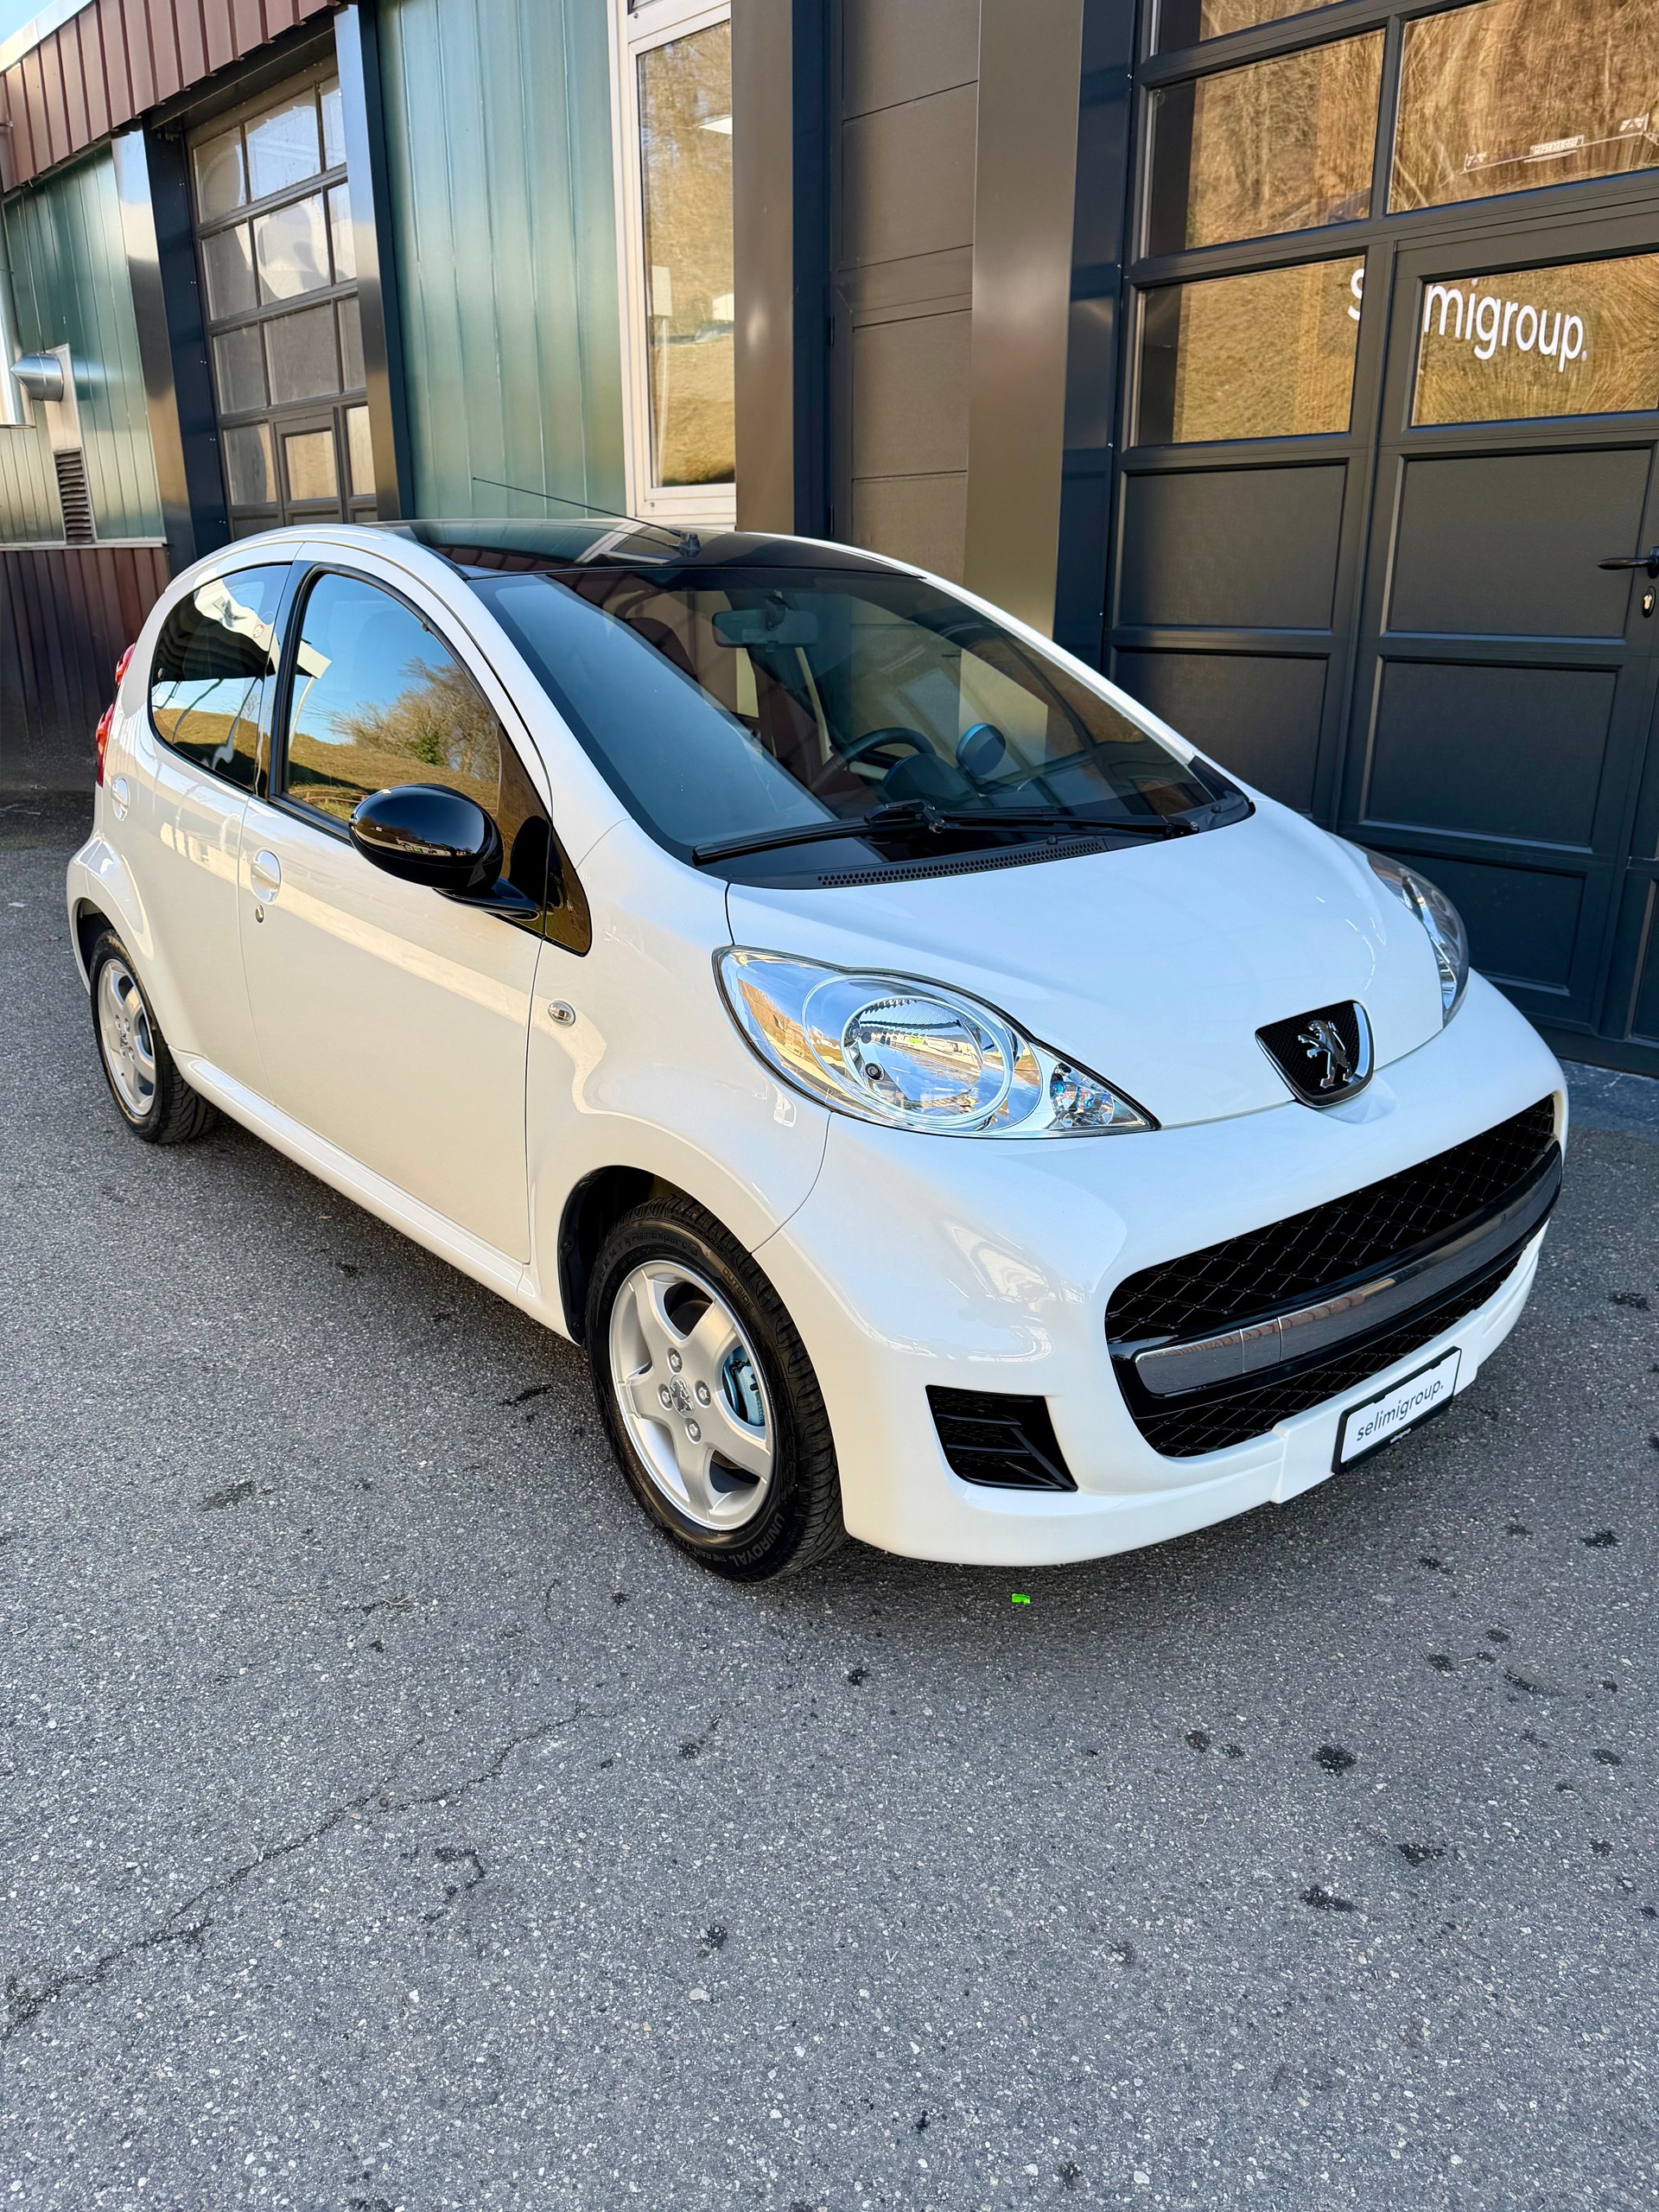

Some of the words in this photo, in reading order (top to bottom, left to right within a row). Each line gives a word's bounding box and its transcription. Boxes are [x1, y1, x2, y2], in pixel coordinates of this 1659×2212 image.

[722, 1267, 754, 1309] OUTSIDE
[1356, 1380, 1444, 1441] selimigroup.
[728, 1512, 785, 1567] UNIROYAL
